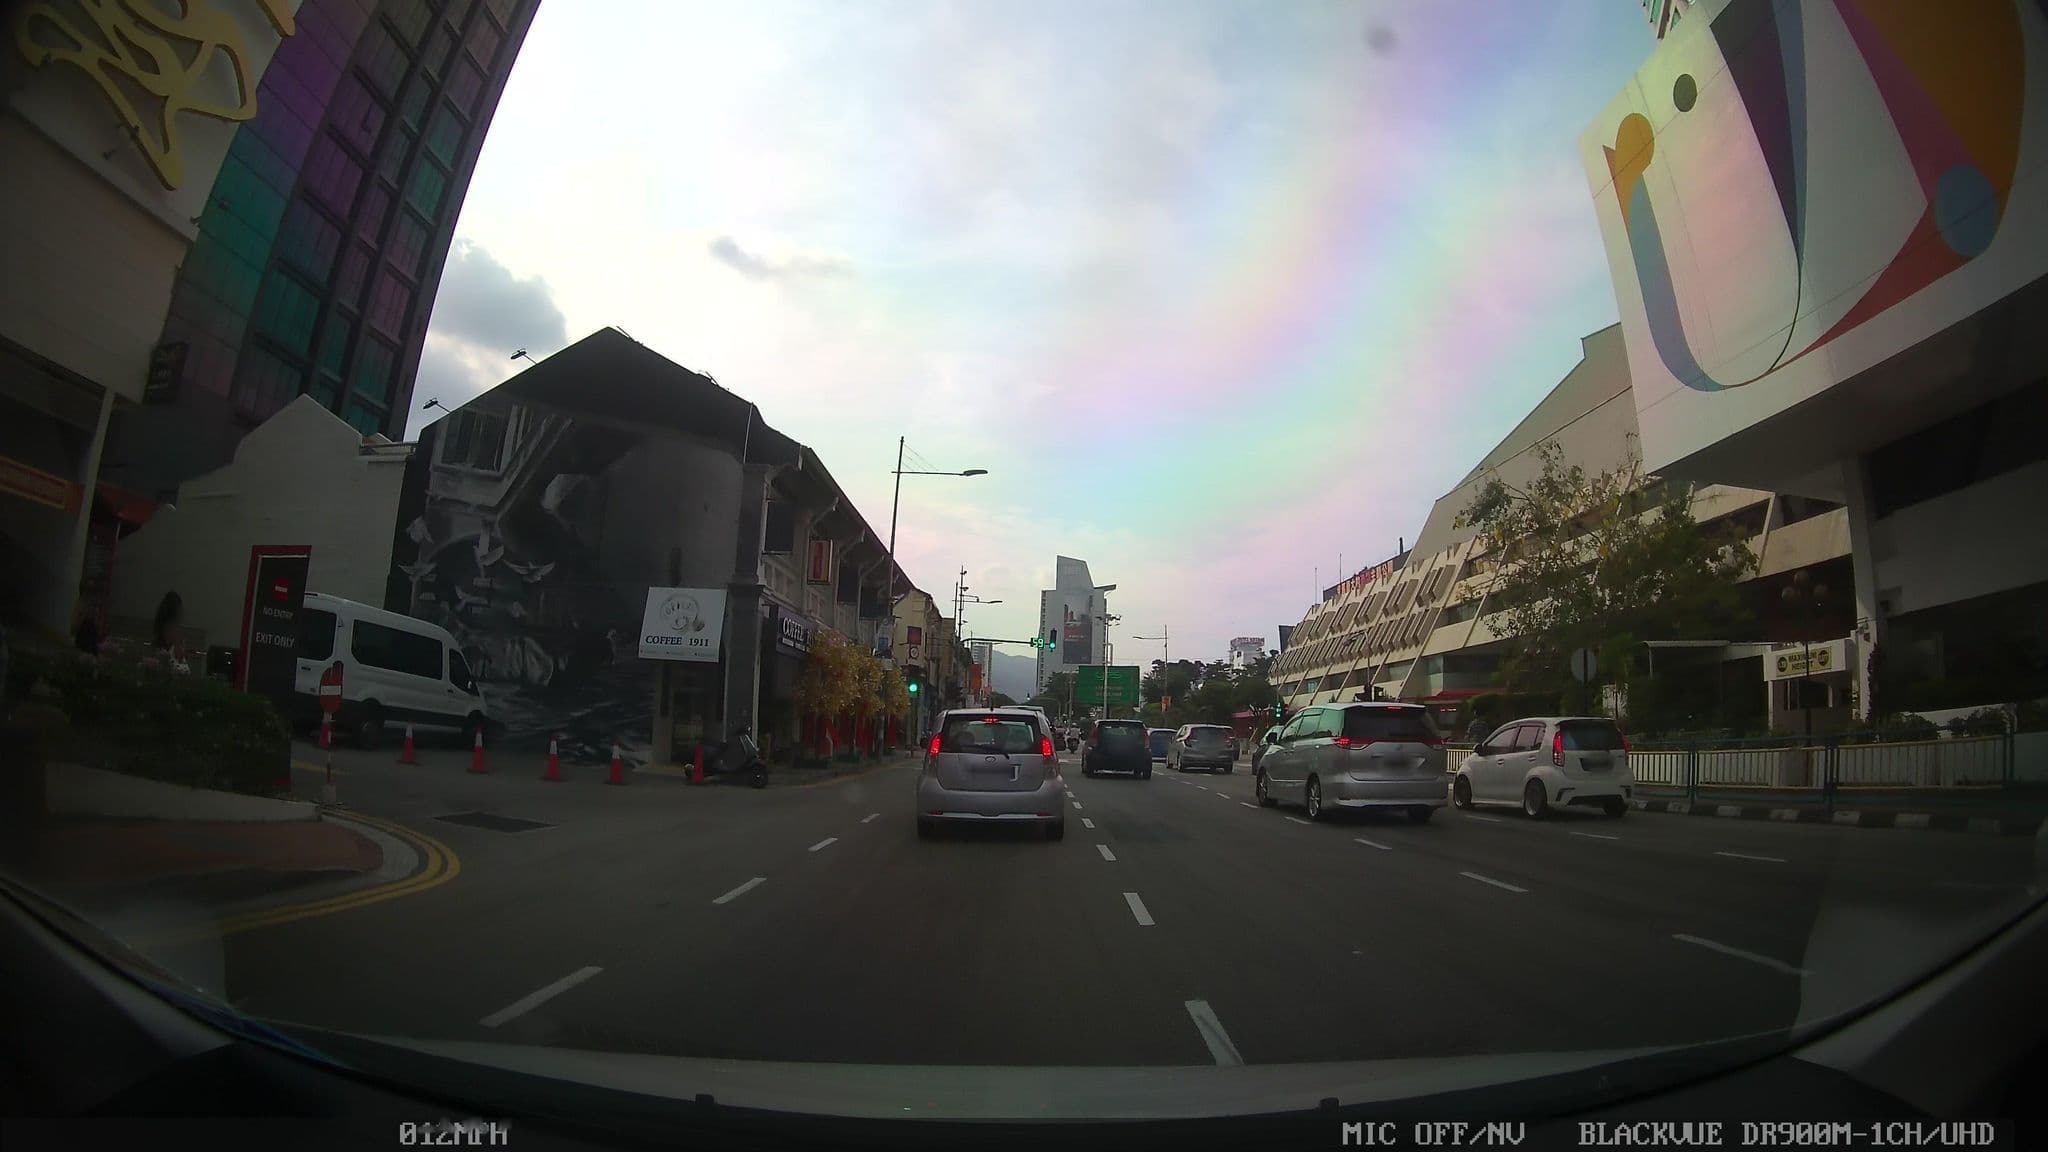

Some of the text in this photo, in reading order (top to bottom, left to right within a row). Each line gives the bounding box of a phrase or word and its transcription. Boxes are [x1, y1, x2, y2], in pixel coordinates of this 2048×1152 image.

[263, 607, 273, 616] NO
[783, 617, 804, 641] COFFEE
[256, 632, 294, 648] EXIT ONLY
[645, 635, 709, 646] COFFEE 1911
[1033, 638, 1043, 647] 59
[1793, 661, 1812, 670] HEIGT
